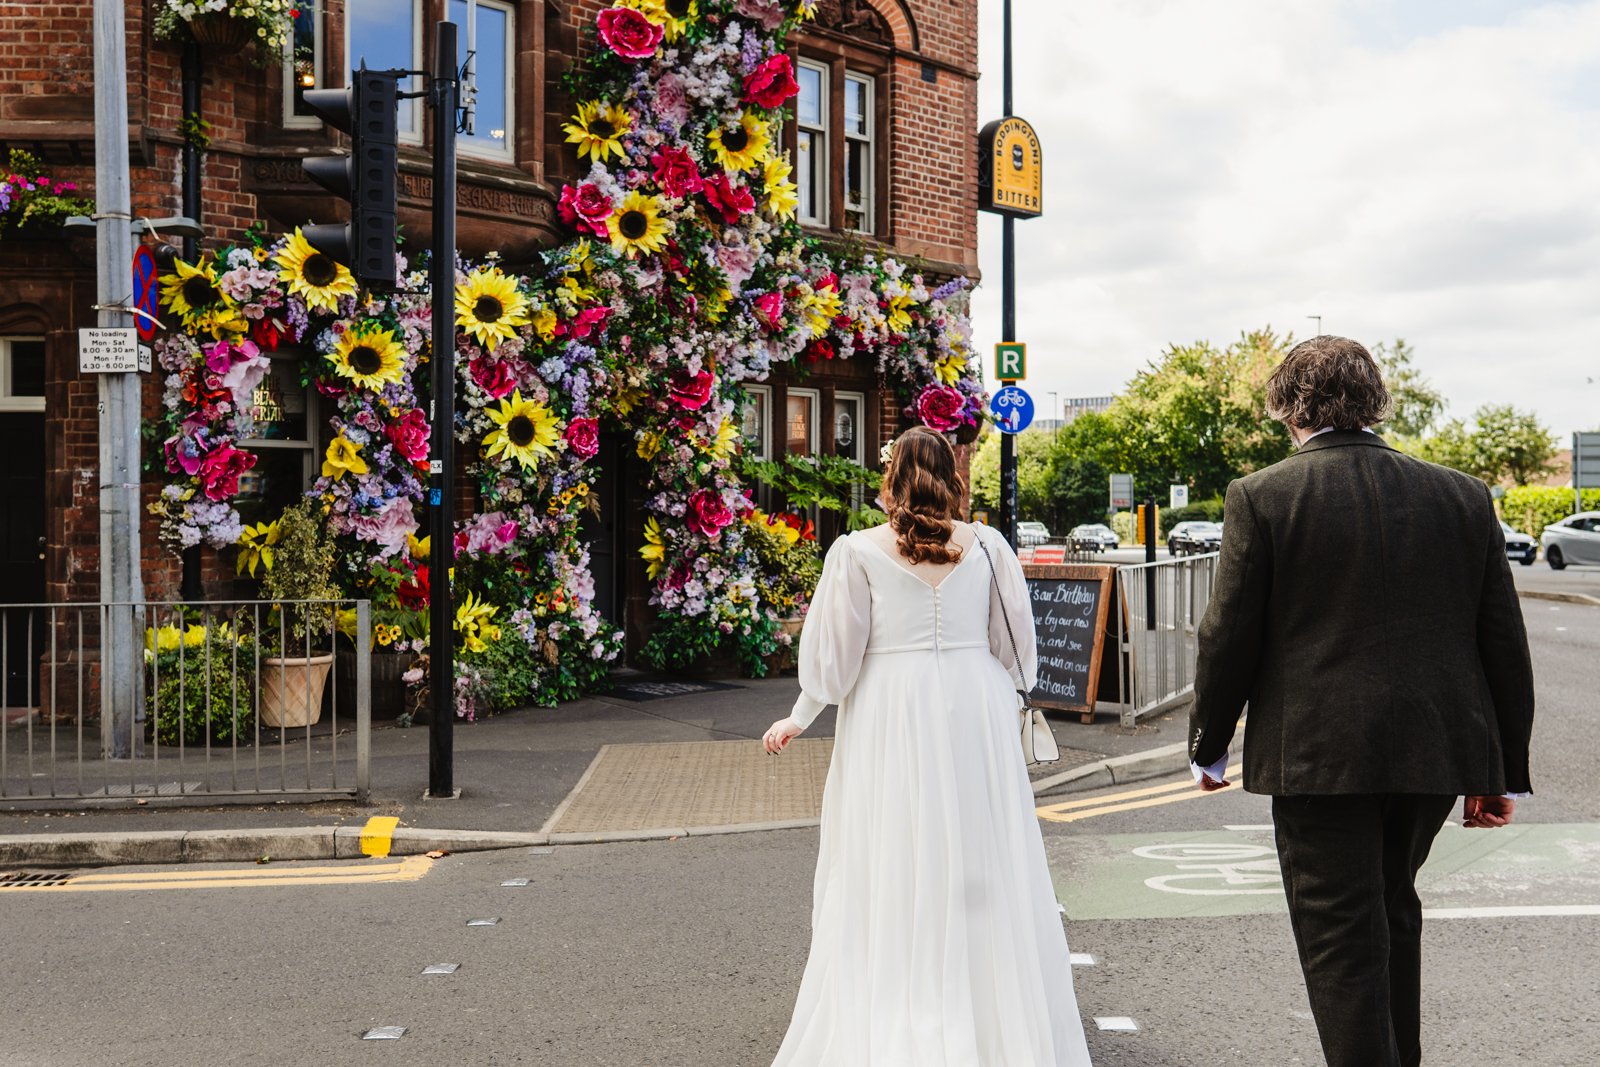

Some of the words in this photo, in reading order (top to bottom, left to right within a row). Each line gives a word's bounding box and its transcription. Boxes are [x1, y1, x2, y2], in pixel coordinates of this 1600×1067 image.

[996, 122, 1039, 165] BODDINGTONS
[997, 188, 1038, 208] BITTER
[1002, 350, 1020, 374] R
[1027, 582, 1039, 601] t's
[1053, 583, 1095, 616] Birthday
[1045, 609, 1058, 632] try
[1058, 617, 1074, 626] our
[1074, 618, 1089, 628] new
[1047, 633, 1067, 648] and
[1067, 640, 1082, 651] see
[1050, 654, 1064, 668] win
[1064, 661, 1074, 671] on
[1075, 664, 1089, 672] our
[1036, 670, 1076, 697] tchcards
